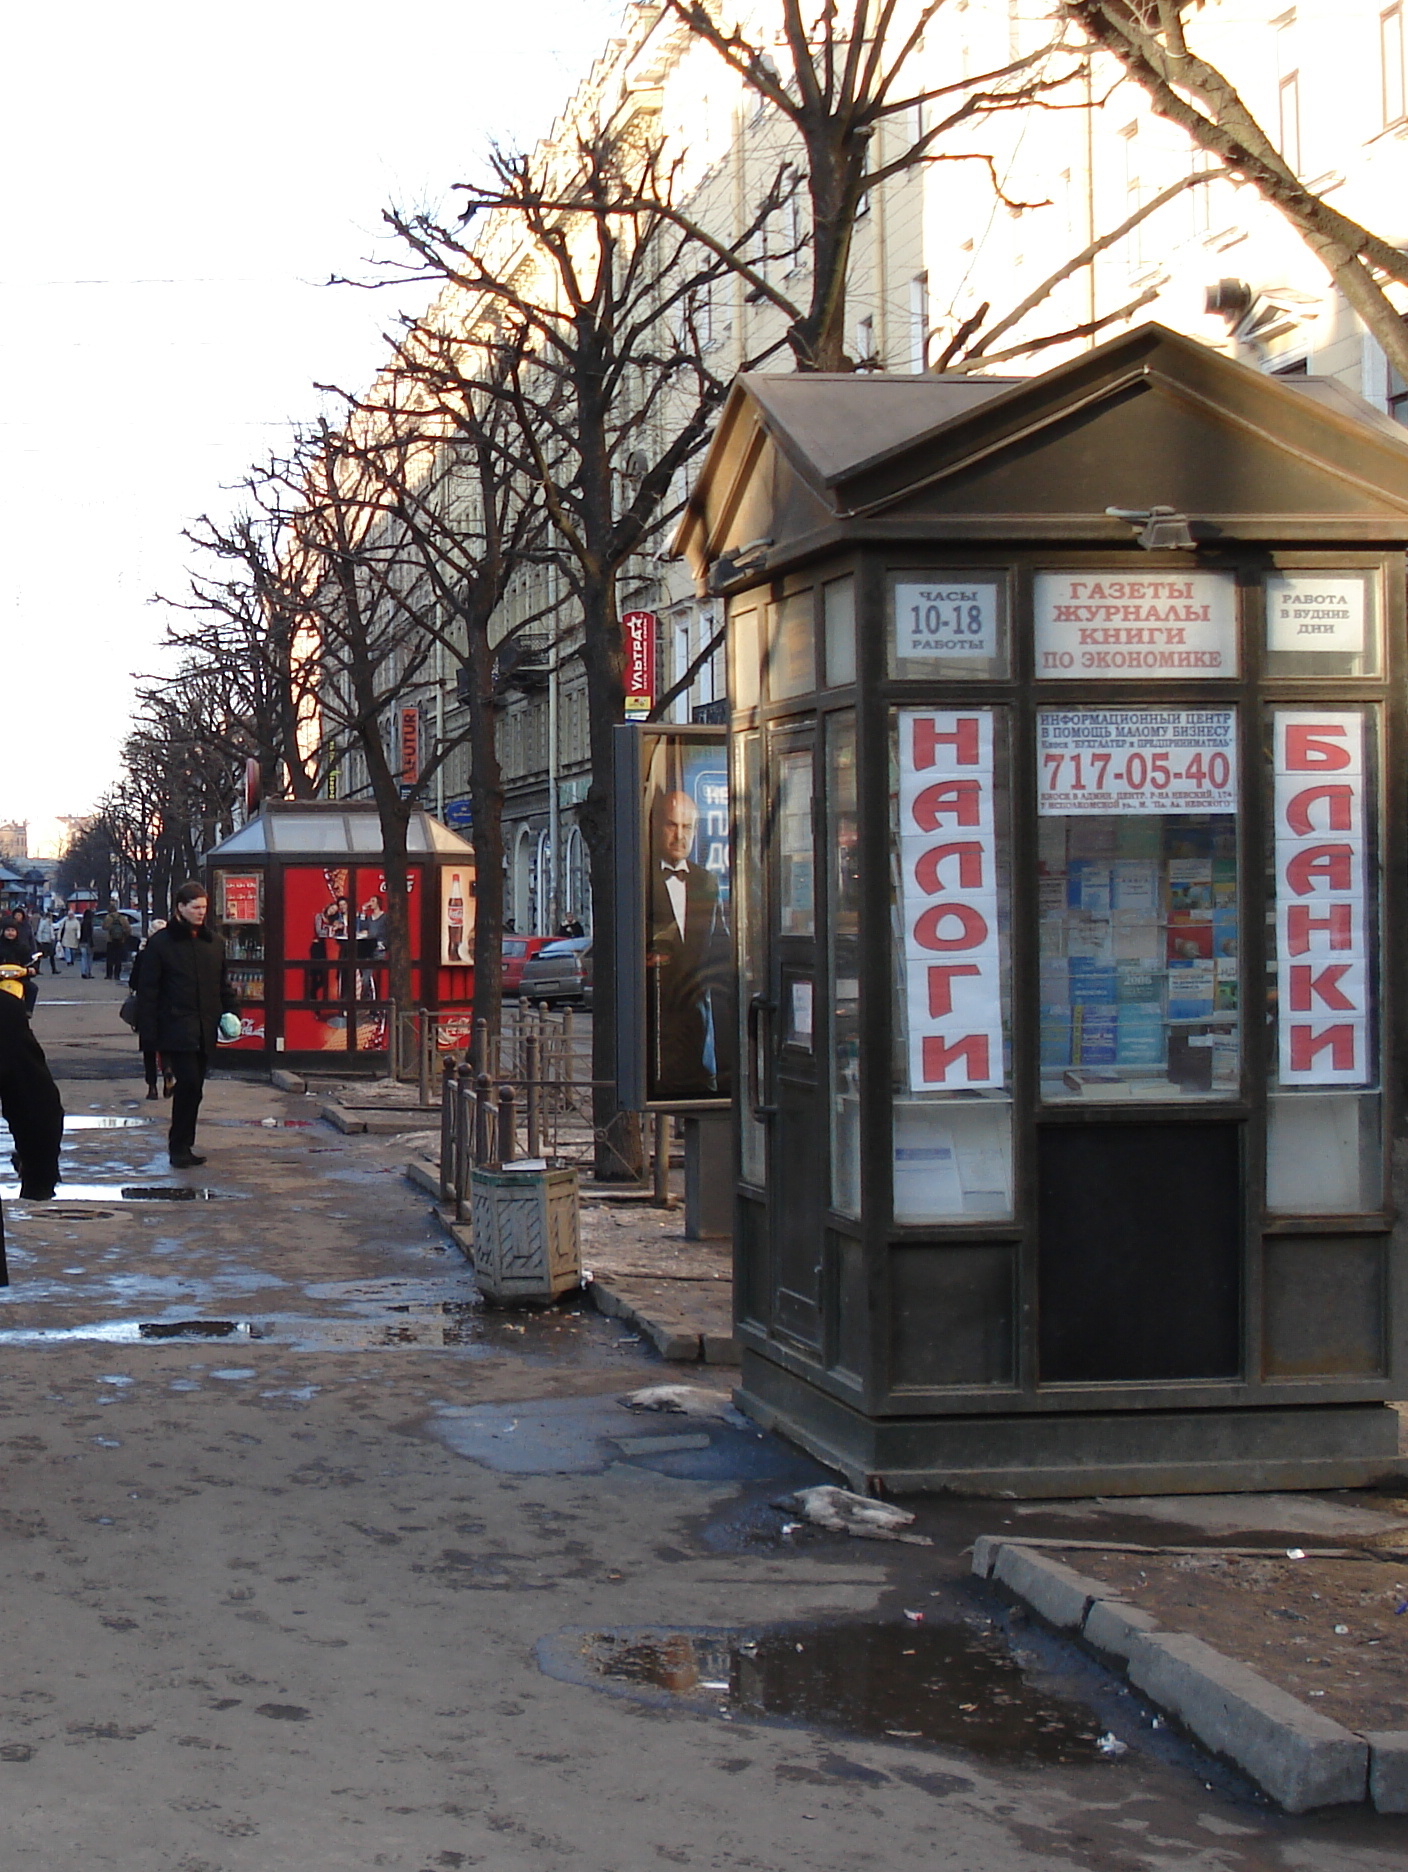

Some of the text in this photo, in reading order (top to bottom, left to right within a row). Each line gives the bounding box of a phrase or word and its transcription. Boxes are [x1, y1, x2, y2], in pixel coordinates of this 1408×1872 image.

[919, 592, 978, 601] ЧАСЫ
[1070, 582, 1194, 599] ГАЗЕТЫ
[1282, 594, 1348, 604] РАБОТА
[911, 605, 982, 634] 10-18
[1053, 605, 1210, 622] ЖУРНАЛЫ
[1280, 609, 1350, 619] В БУДНИЕ
[1079, 628, 1186, 645] КНИГИ
[1297, 624, 1335, 634] ДНИ
[912, 640, 984, 649] РАБОТЫ
[1043, 651, 1222, 668] ПО ЭКОНОМИКЕ
[1186, 713, 1231, 725] ЦЕНТР
[1042, 726, 1230, 738] В ПОМОЩЬ МАЛОМУ БИЗНЕСУ
[1044, 752, 1230, 790] 717-05-40
[912, 717, 990, 1084] НАЛОГИ
[1285, 724, 1358, 1072] БЛАНКИ
